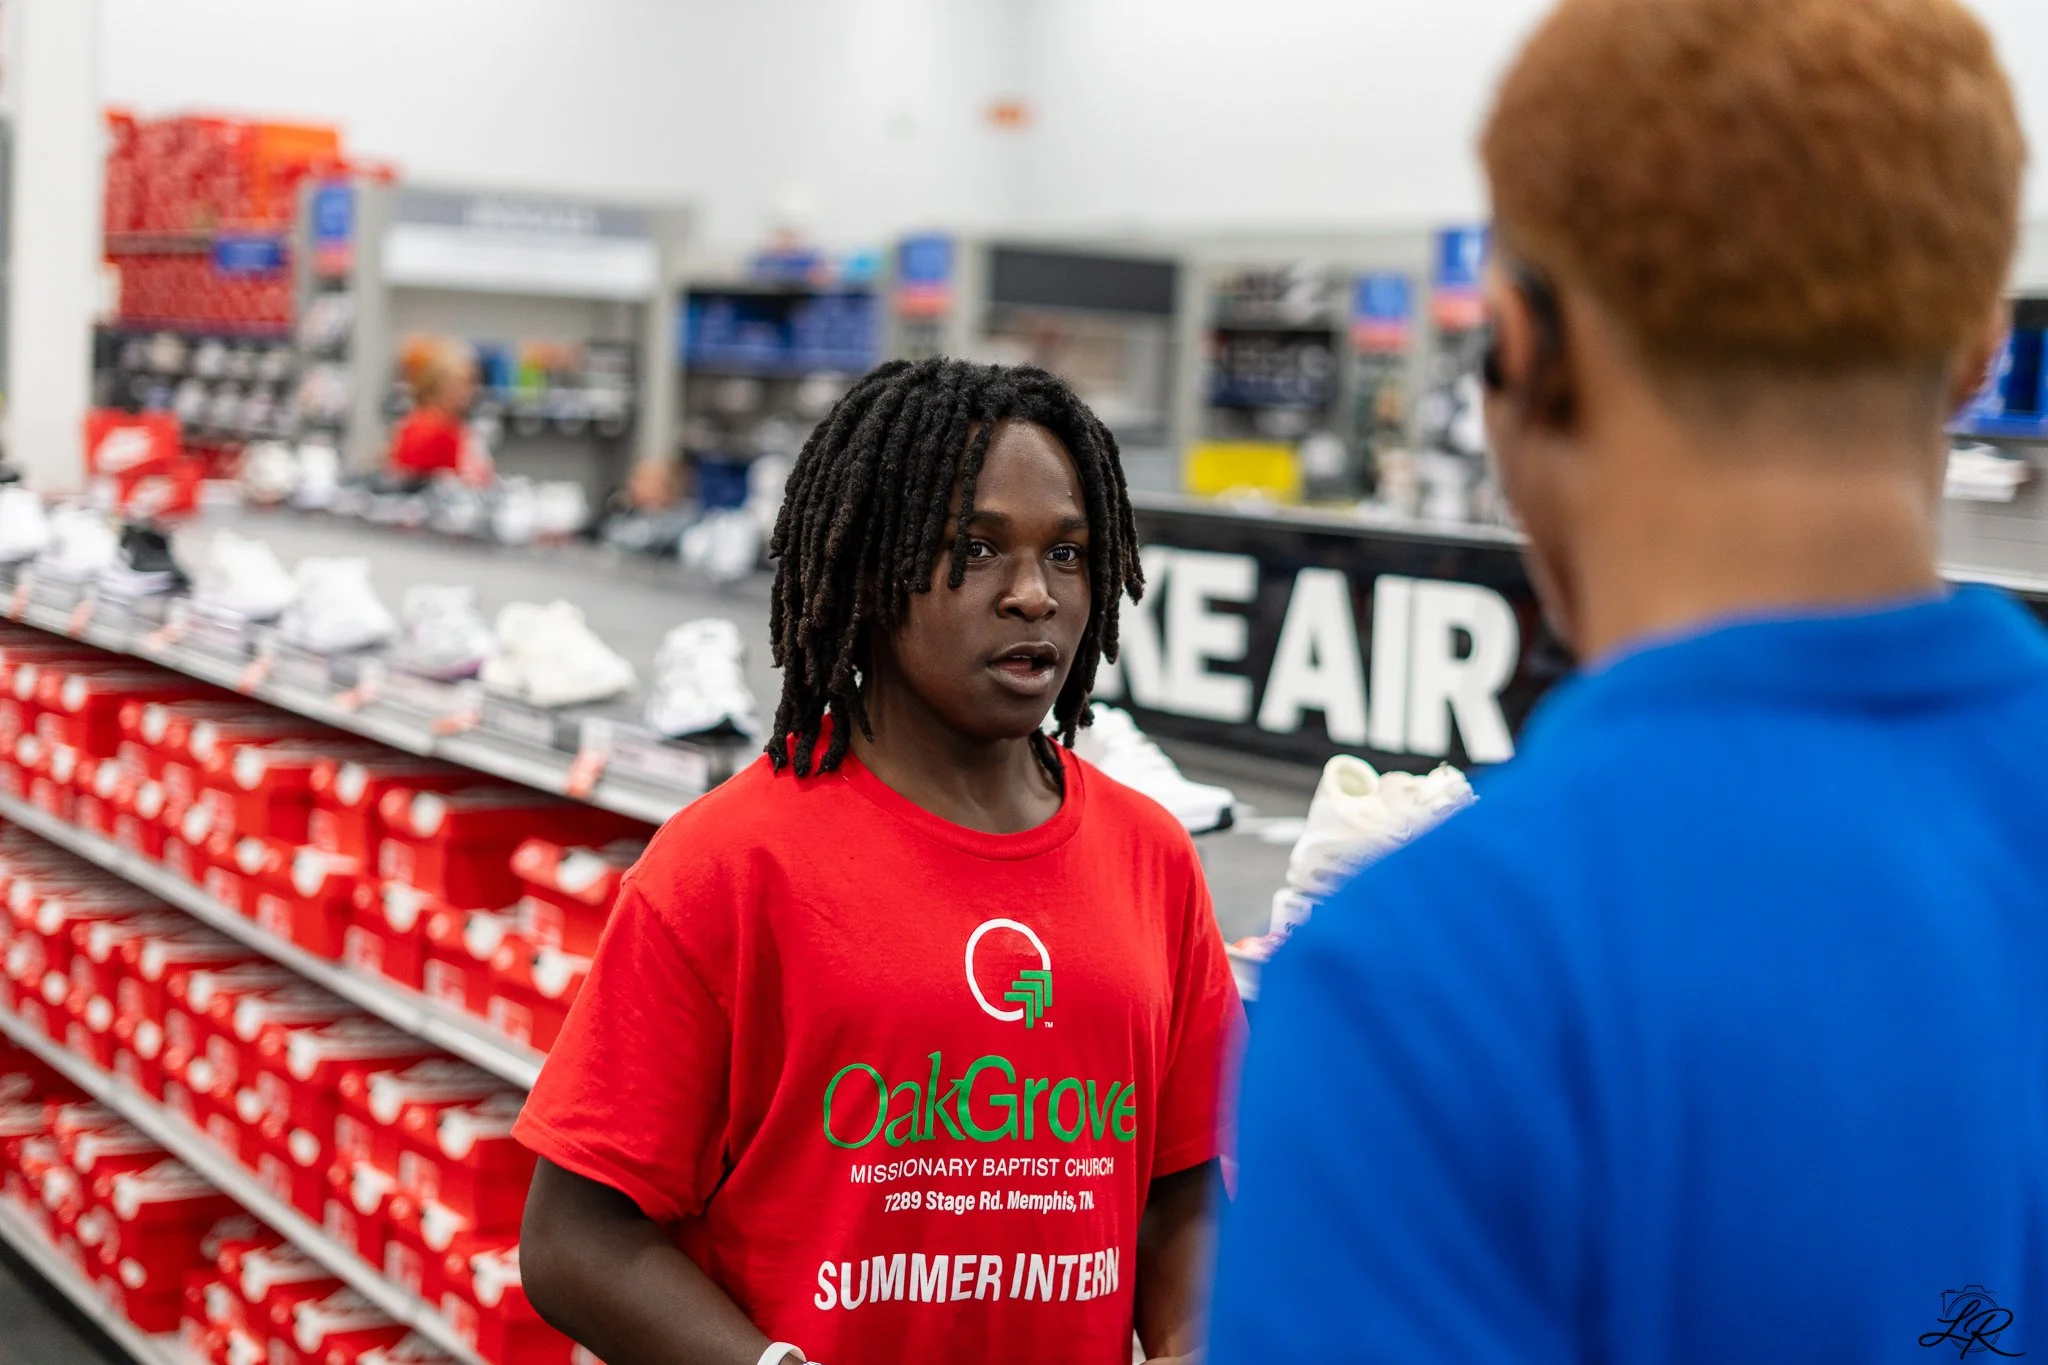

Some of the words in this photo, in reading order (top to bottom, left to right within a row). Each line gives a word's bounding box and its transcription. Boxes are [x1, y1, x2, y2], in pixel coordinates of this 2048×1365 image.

[1090, 545, 1257, 722] KE
[1258, 568, 1519, 763] AIR
[850, 1158, 976, 1183] MISSIONARY
[982, 1158, 1060, 1178] BAPTIST
[1064, 1156, 1114, 1177] CHURCH
[884, 1191, 922, 1212] 7289
[925, 1191, 975, 1215] Stage
[979, 1191, 1004, 1211] Rd.
[1006, 1190, 1077, 1215] Memphis,
[814, 1253, 1003, 1310] SUMMER
[1009, 1247, 1120, 1302] INTERN
